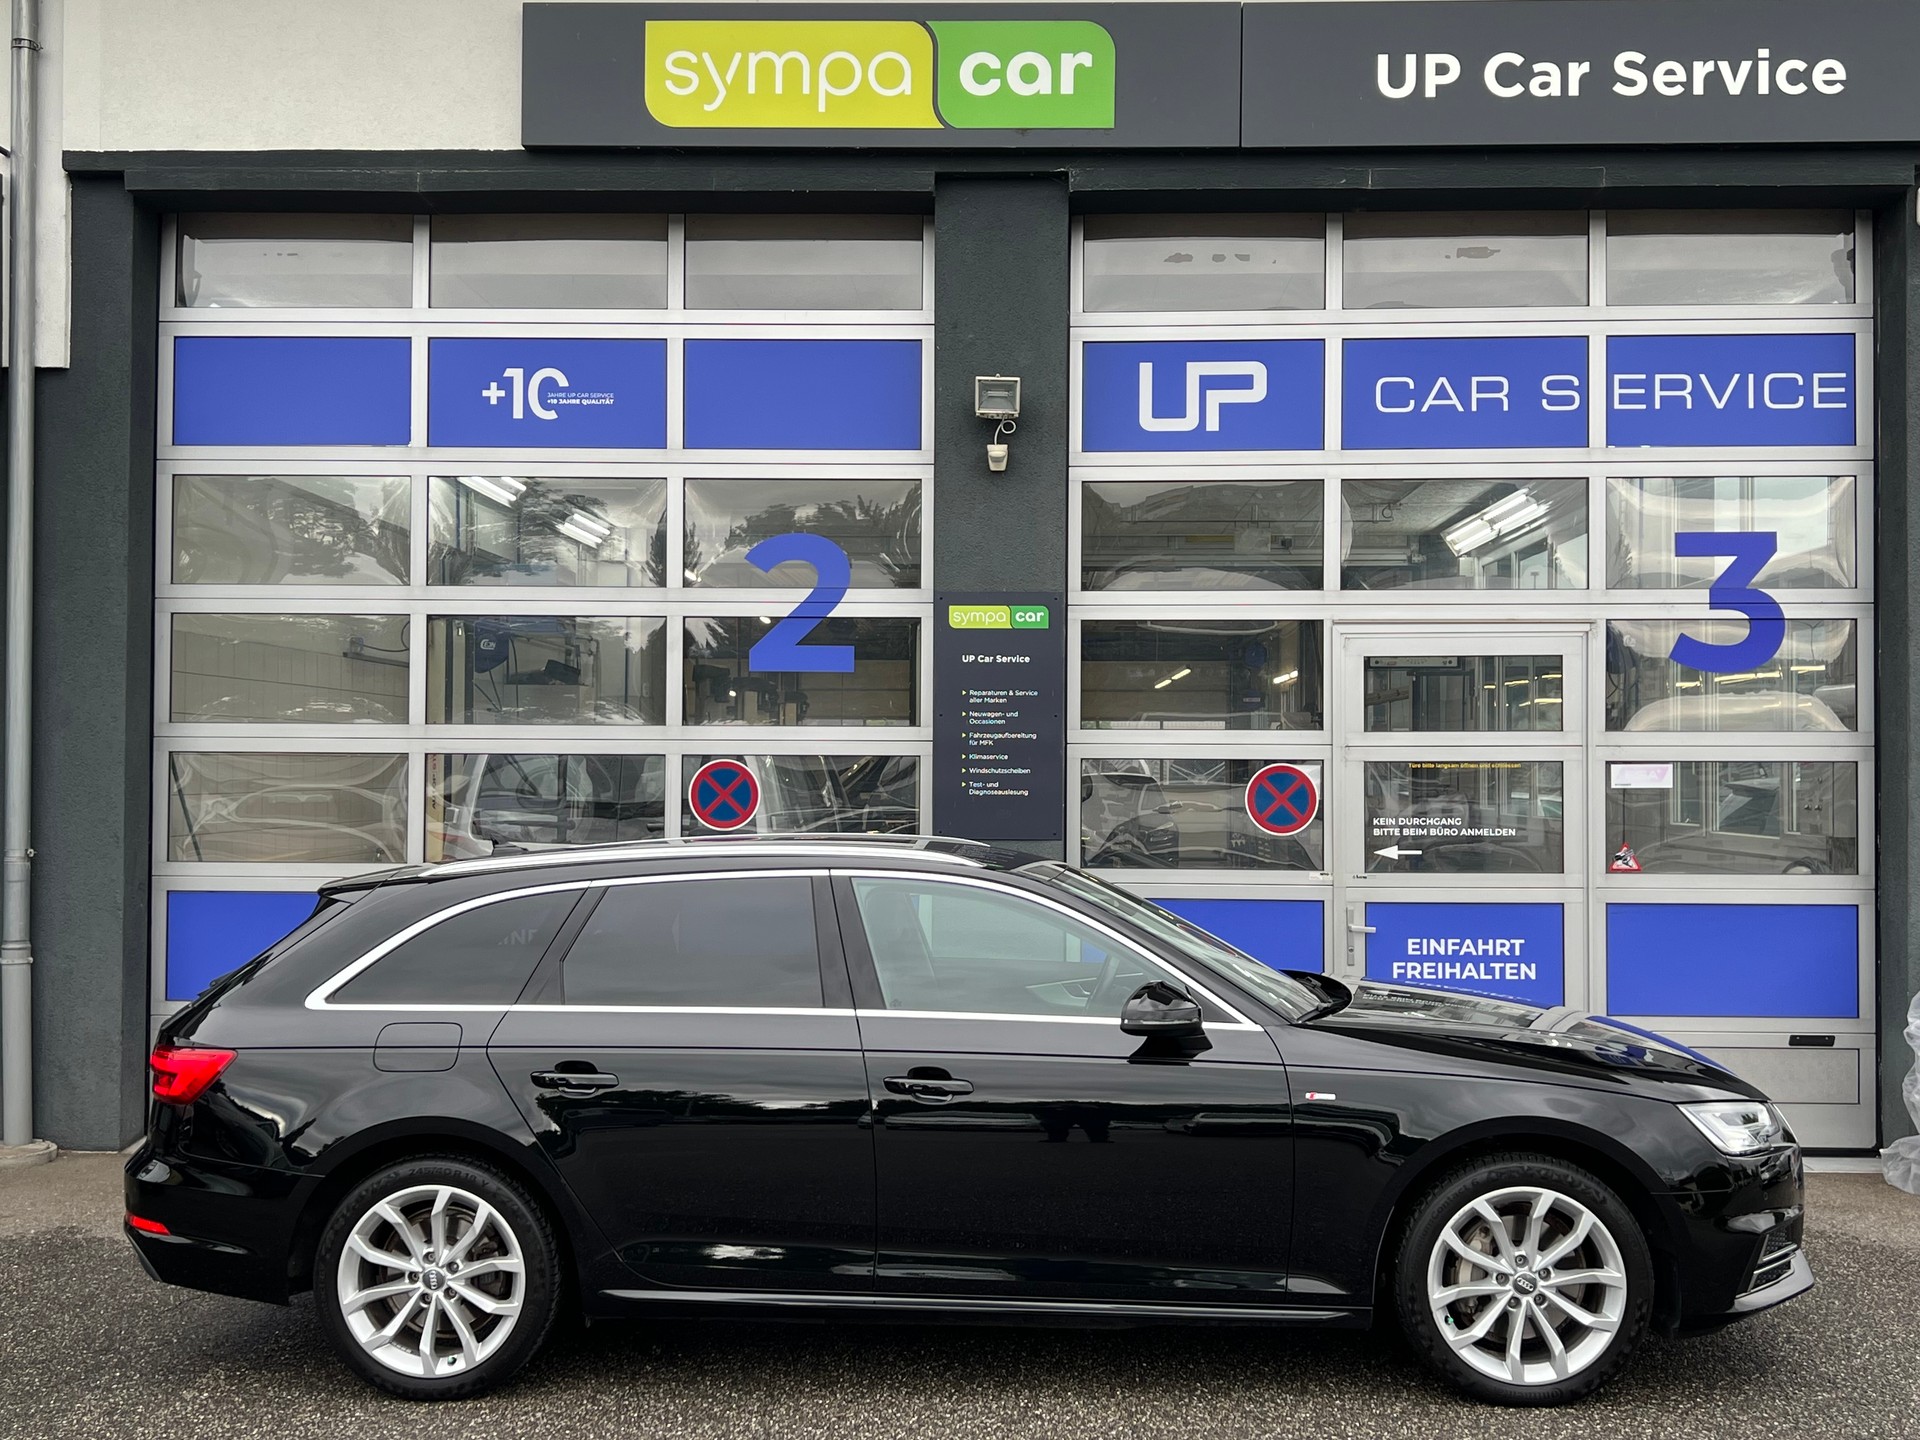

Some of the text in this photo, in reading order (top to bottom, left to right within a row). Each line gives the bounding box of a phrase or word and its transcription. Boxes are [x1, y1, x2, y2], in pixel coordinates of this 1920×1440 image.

[664, 49, 1093, 112] sympa car
[1377, 48, 1847, 99] UP Car Service
[1138, 361, 1268, 432] UP
[1375, 376, 1509, 412] CAR
[744, 532, 855, 673] 2
[1669, 531, 1786, 673] 3
[953, 611, 1044, 625] sympa car
[961, 654, 1031, 663] UP Car Service
[969, 689, 1008, 697] Reparaturen
[969, 732, 1037, 740] Fahrzeugaufbereitung
[1373, 817, 1462, 826] KEIN DURCHGANG
[1373, 827, 1516, 837] BITTE BEIM BÜRO ANMELDEN
[1407, 938, 1525, 956] EINFAHRT
[1392, 962, 1537, 980] FREIHALTEN
